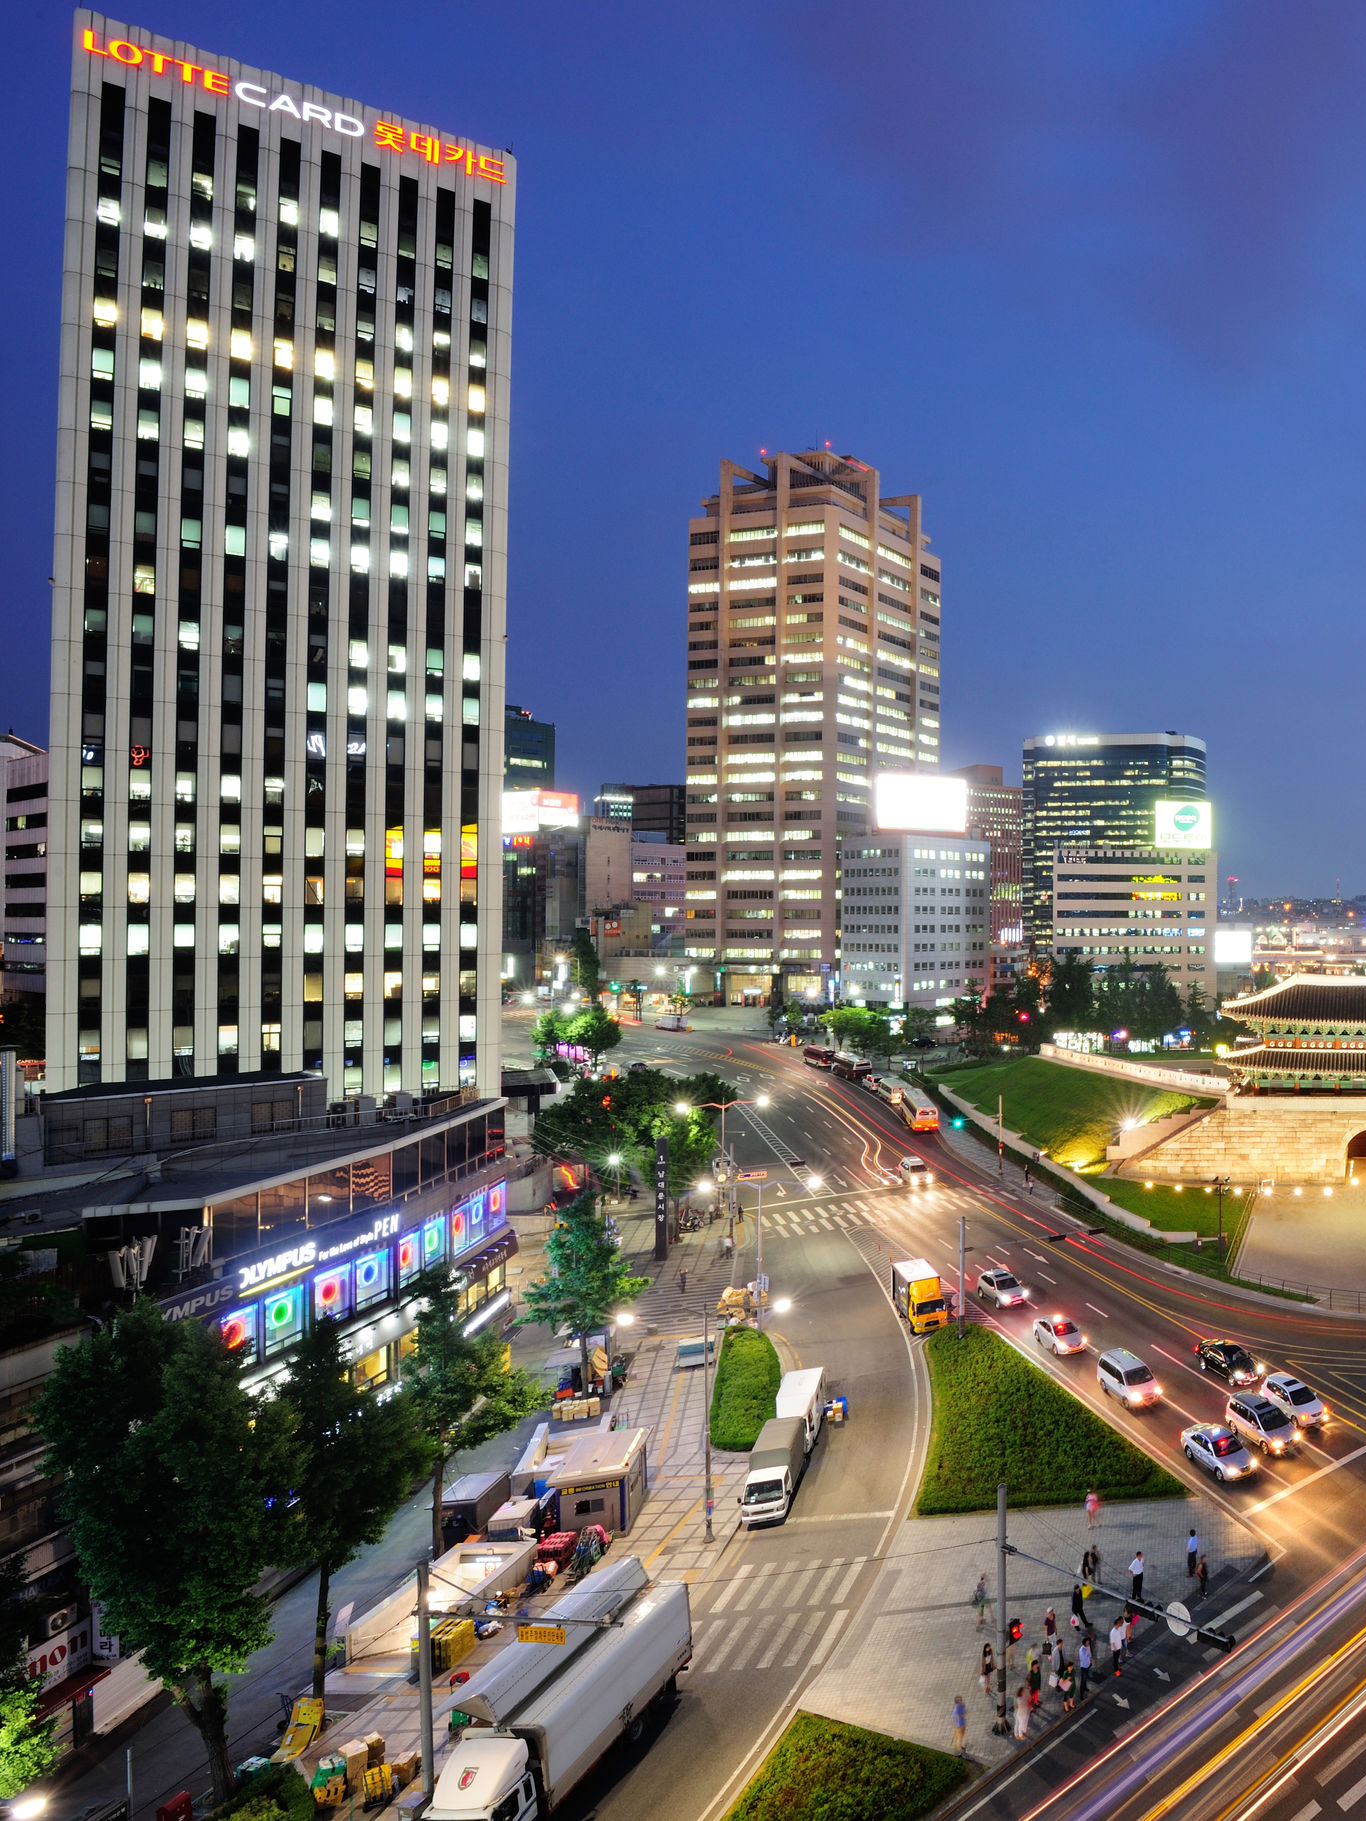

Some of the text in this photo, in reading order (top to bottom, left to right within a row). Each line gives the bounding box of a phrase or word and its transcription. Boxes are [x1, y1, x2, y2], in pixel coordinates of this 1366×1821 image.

[373, 118, 508, 185] 롯데카드
[657, 1170, 665, 1222] 남대문시장
[374, 1213, 400, 1241] PEN
[161, 1284, 234, 1321] YMPUS
[22, 1629, 88, 1680] non
